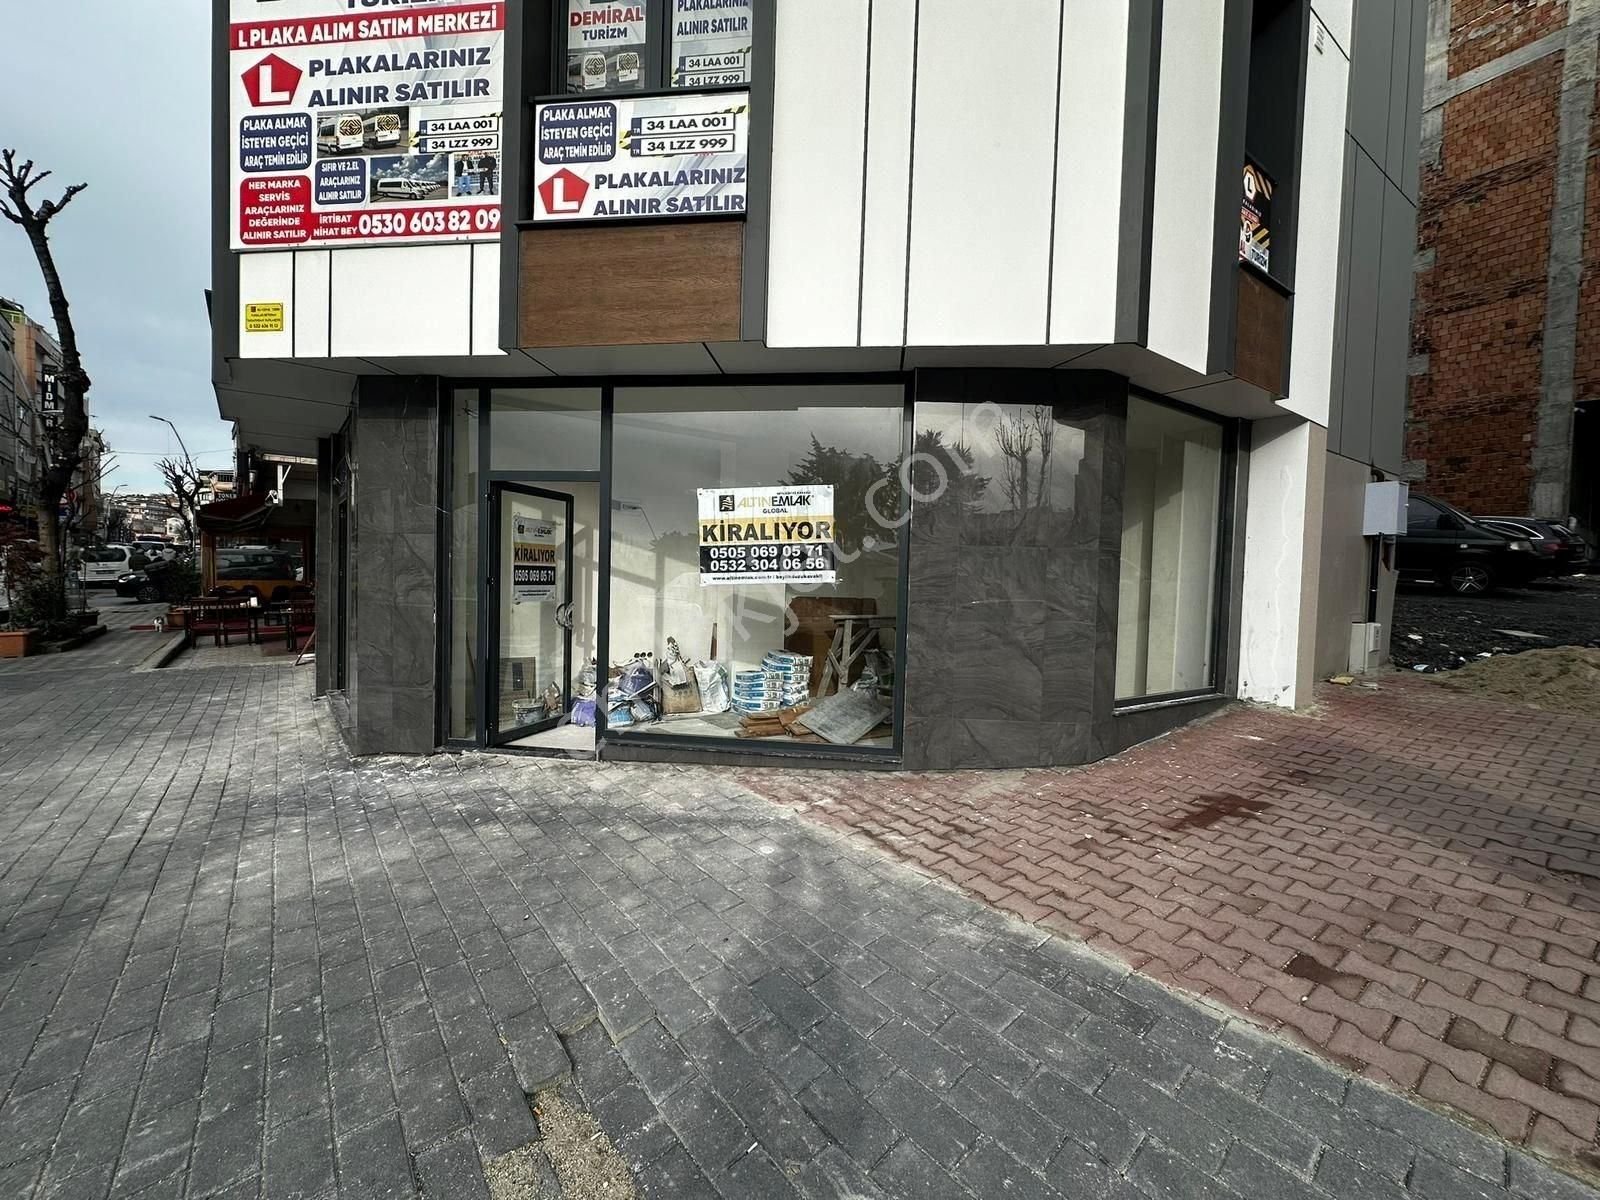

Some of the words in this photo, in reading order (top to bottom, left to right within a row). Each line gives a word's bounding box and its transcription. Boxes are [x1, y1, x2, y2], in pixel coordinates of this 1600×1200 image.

[570, 5, 644, 28] DEMİRAL
[238, 29, 248, 47] L
[250, 25, 310, 46] PLAKA
[311, 21, 354, 44] ALIM
[358, 16, 414, 38] SATIM
[418, 5, 497, 34] MERKEZİ
[582, 25, 628, 41] TURİZM
[677, 20, 709, 36] ALINIR
[711, 16, 748, 34] SATILIR
[308, 47, 491, 77] PLAKALARINIZ
[688, 58, 700, 68] 34
[703, 58, 722, 67] LAA
[723, 56, 740, 66] 001
[259, 65, 290, 103] L
[688, 76, 700, 86] 34
[703, 76, 720, 85] LZZ
[722, 74, 740, 84] 999
[308, 83, 390, 108] ALINIR
[395, 78, 490, 102] SATILIR
[543, 108, 575, 122] PLAKA
[576, 106, 612, 120] ALMAK
[243, 116, 275, 131] PLAKA
[274, 114, 307, 129] ALMAK
[430, 122, 446, 132] 34
[448, 121, 471, 131] LAA
[473, 120, 493, 129] 001
[646, 120, 665, 131] 34
[669, 118, 698, 130] LAA
[701, 116, 727, 128] 001
[541, 125, 581, 141] İSTEYEN
[581, 122, 613, 141] GEÇİCİ
[241, 135, 277, 150] İSTEYEN
[277, 133, 309, 149] GEÇİCİ
[432, 140, 446, 150] 34
[448, 139, 469, 149] LZZ
[471, 138, 493, 148] 999
[647, 141, 666, 152] 34
[670, 140, 696, 150] LZZ
[699, 138, 728, 149] 999
[543, 146, 566, 161] ARAÇ
[565, 143, 588, 157] TEMİN
[588, 141, 612, 156] EDİLİR
[244, 156, 264, 170] ARAÇ
[264, 153, 286, 166] TEMİN
[286, 151, 308, 165] EDİLİR
[322, 162, 337, 173] SIFIR
[338, 161, 346, 171] VE
[248, 180, 266, 190] HER
[267, 178, 301, 189] MARKA
[320, 176, 361, 188] ARAÇLARINIZ
[594, 168, 746, 190] PLAKALARINIZ
[258, 190, 291, 202] SERVİS
[318, 191, 338, 201] ALINIR
[339, 190, 362, 200] SATILIR
[552, 178, 579, 210] L
[244, 203, 305, 217] ARAÇLARINIZ
[594, 198, 662, 216] ALINIR
[666, 194, 744, 212] SATILIR
[248, 215, 301, 228] DEĞERİNDE
[319, 213, 352, 224] İRTİBAT
[358, 213, 406, 235] 0530
[409, 211, 447, 233] 603
[447, 210, 471, 231] 82
[475, 208, 501, 230] 09
[242, 229, 272, 240] ALINIR
[272, 228, 307, 239] SATILIR
[313, 226, 339, 237] NİHAT
[340, 226, 358, 236] BEY
[737, 494, 812, 508] ALTINEMLAK
[702, 520, 832, 542] KİRALIYOR
[710, 546, 746, 559] 0505
[750, 546, 778, 558] 069
[782, 545, 801, 557] 05
[806, 544, 824, 556] 71
[710, 559, 746, 572] 0532
[751, 558, 778, 571] 304
[782, 558, 801, 570] 06
[806, 558, 825, 570] 56
[514, 570, 529, 582] 0505
[530, 570, 540, 582] 069
[540, 570, 548, 582] 05
[548, 570, 554, 582] 71
